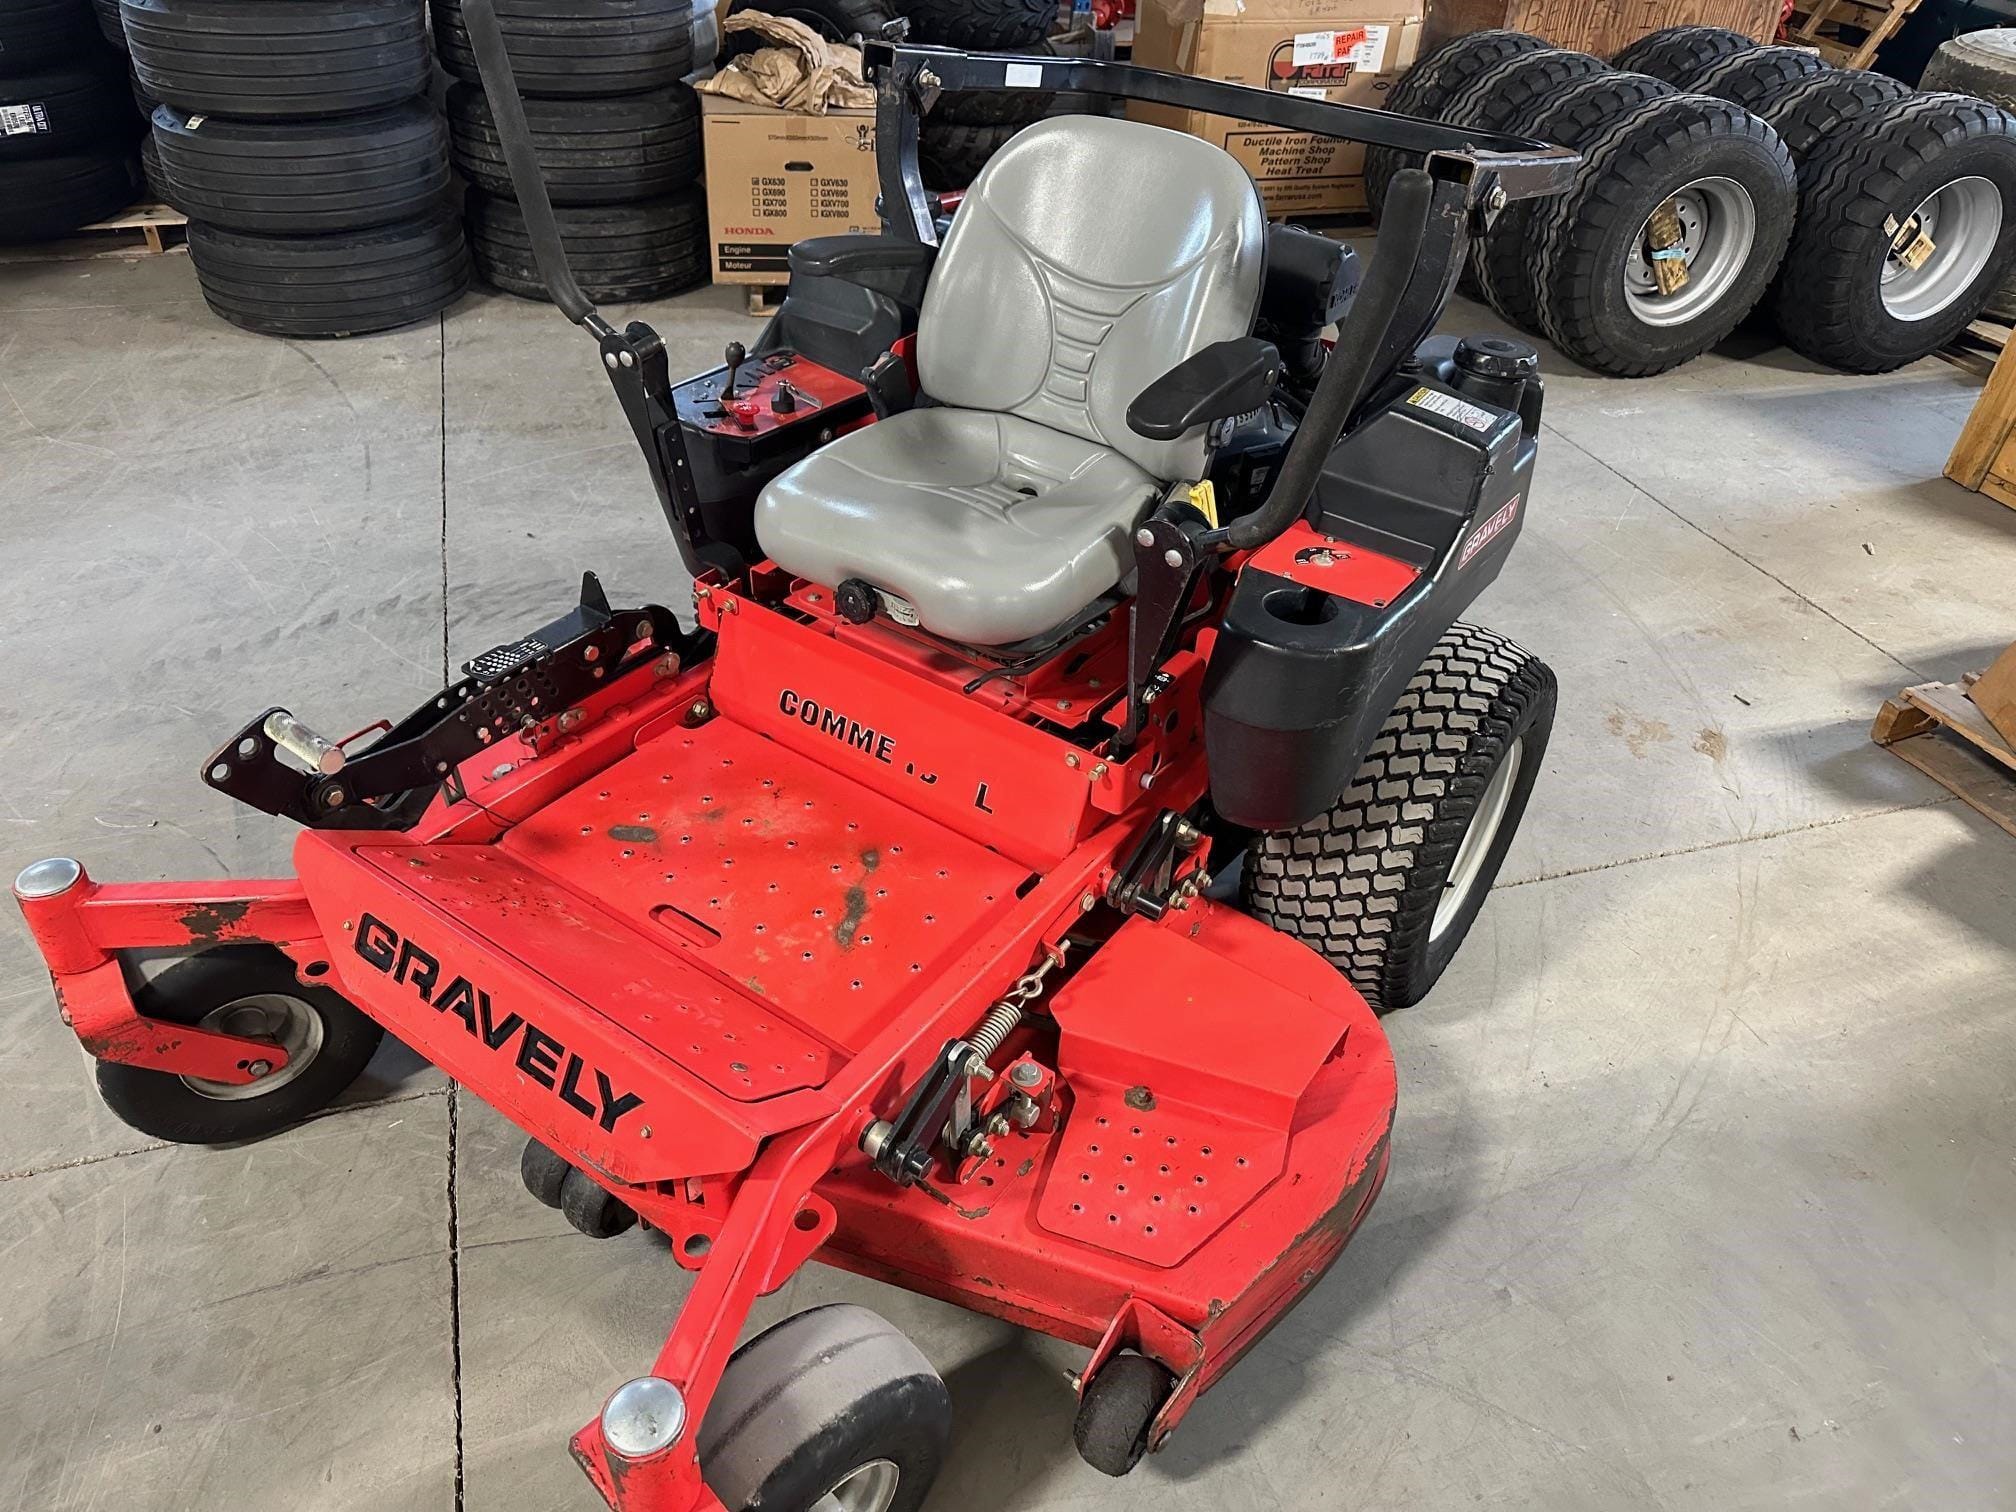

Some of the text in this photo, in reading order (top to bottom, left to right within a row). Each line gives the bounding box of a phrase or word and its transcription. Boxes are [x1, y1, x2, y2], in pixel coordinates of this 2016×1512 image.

[1335, 31, 1364, 45] REPAIR
[1243, 136, 1282, 147] Ductile
[1285, 136, 1307, 146] Iron
[1258, 145, 1336, 157] Machine Shop
[1260, 155, 1331, 166] Pattern Shop
[1265, 165, 1324, 176] Heat Treat
[762, 178, 786, 186] GX630
[820, 179, 848, 187] GXV630
[762, 188, 786, 196] GX690
[820, 189, 848, 197] GXV690
[724, 227, 775, 236] HONDA
[724, 246, 752, 255] Engine
[725, 261, 753, 270] Moteur
[1461, 499, 1518, 561] GRAVELY
[779, 689, 993, 815] COMMEL
[355, 912, 646, 1133] GRAVELY
